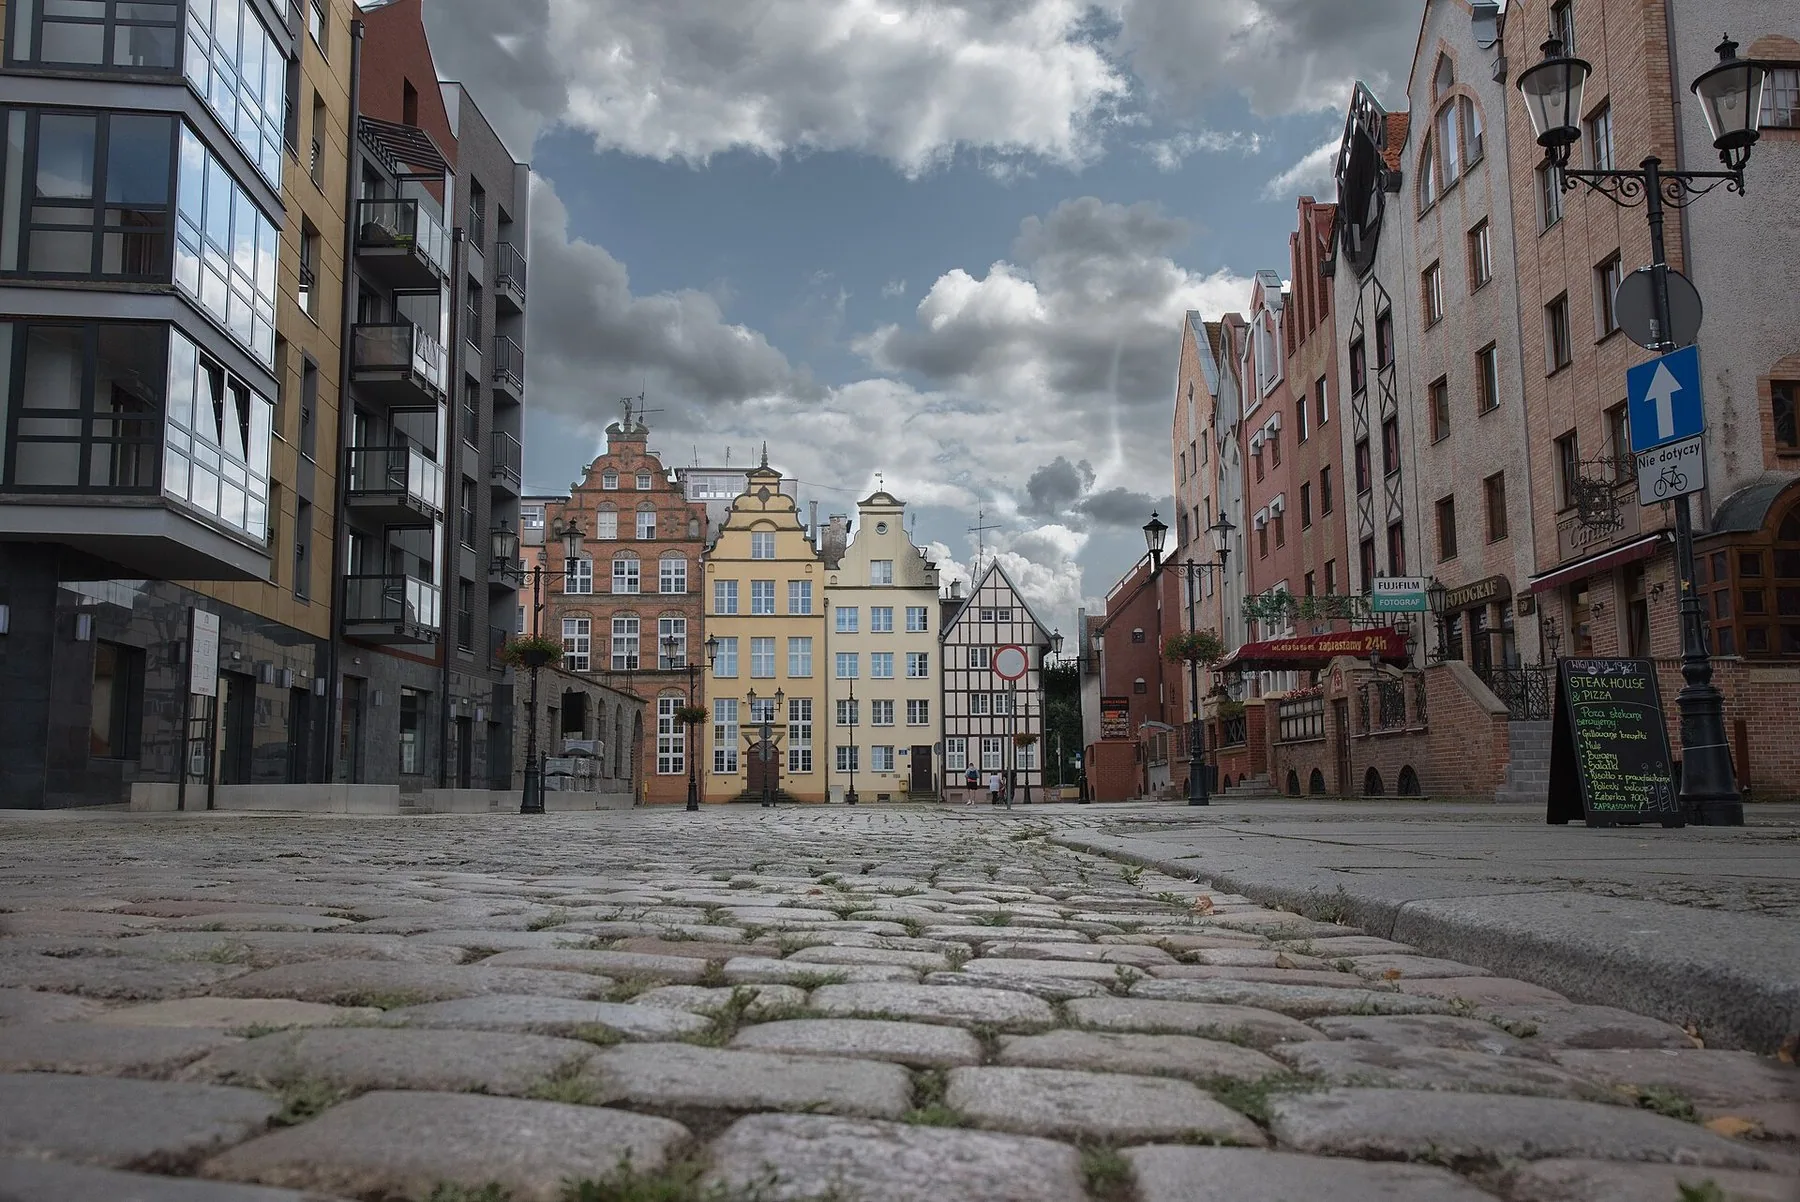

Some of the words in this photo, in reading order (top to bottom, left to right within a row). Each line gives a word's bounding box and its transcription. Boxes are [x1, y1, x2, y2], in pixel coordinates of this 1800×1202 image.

[1638, 456, 1656, 469] Nie
[1659, 443, 1700, 462] dotyczy
[1557, 520, 1574, 532] CAFE
[1378, 581, 1420, 590] FUJIFILM
[1446, 580, 1497, 608] FOTOGRAF
[1379, 598, 1421, 606] FOTOGRAF
[1318, 640, 1362, 652] zapraszamy
[1364, 635, 1388, 651] 24h
[1570, 676, 1609, 689] STEAK
[1610, 678, 1646, 690] HOUSE
[1572, 691, 1581, 702] &
[1582, 690, 1613, 701] PIZZA
